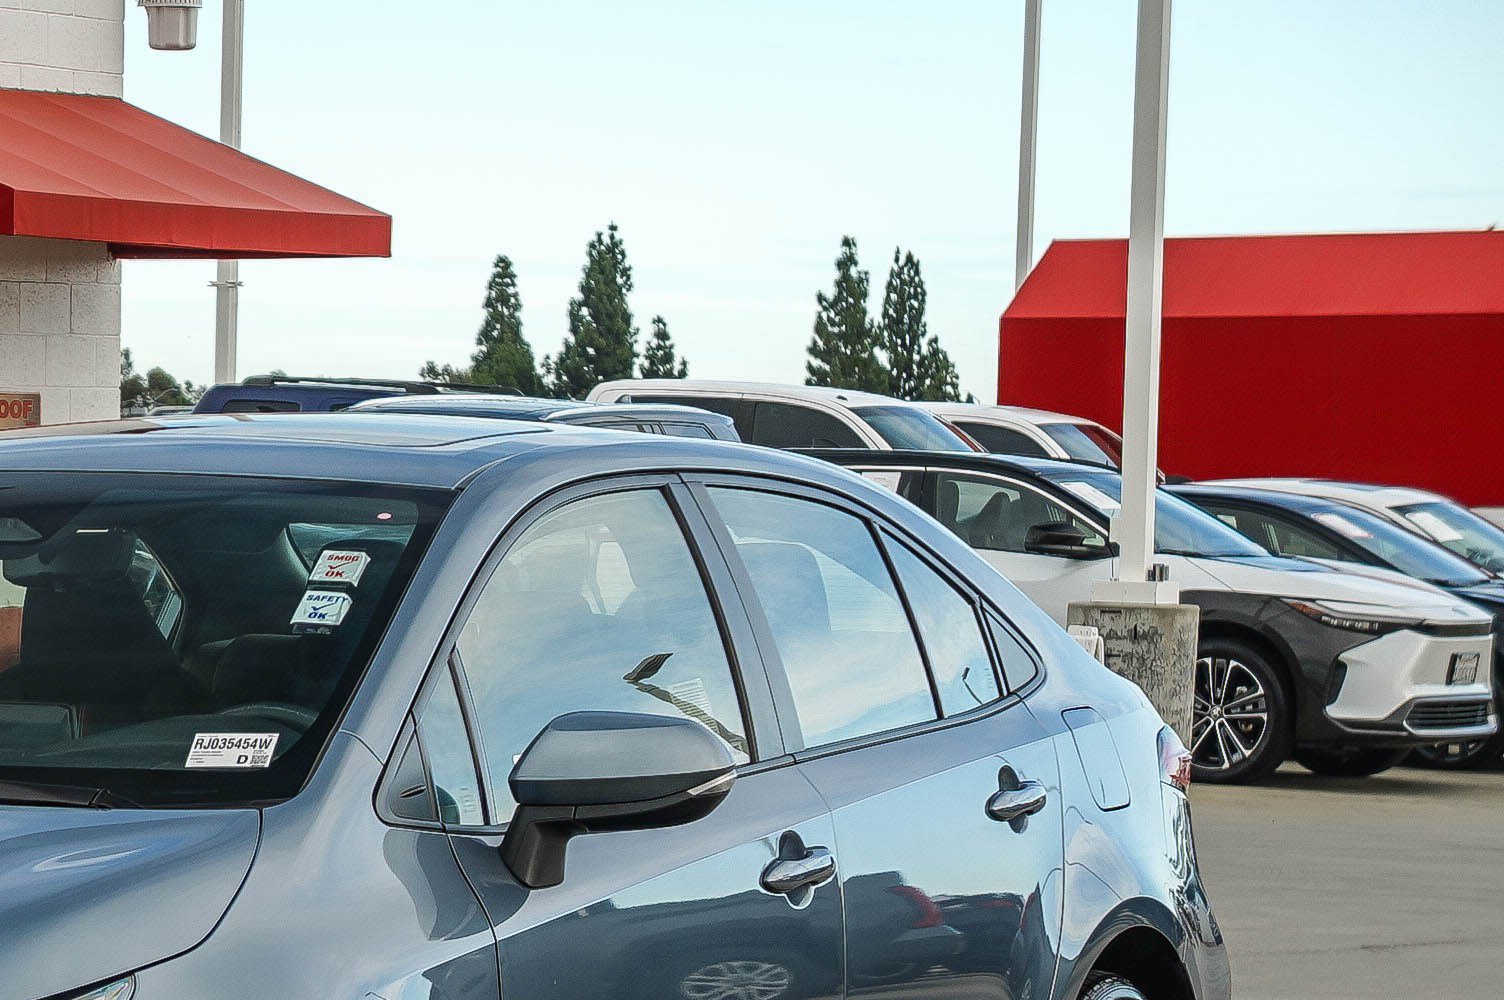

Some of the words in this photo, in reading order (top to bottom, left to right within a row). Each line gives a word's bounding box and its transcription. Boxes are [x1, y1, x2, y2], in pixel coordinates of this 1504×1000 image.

[327, 554, 360, 562] SMOG
[325, 570, 345, 578] OK
[306, 594, 348, 603] SAFETY
[307, 611, 328, 620] OK
[194, 737, 273, 750] RJ035454W
[236, 754, 248, 765] D
